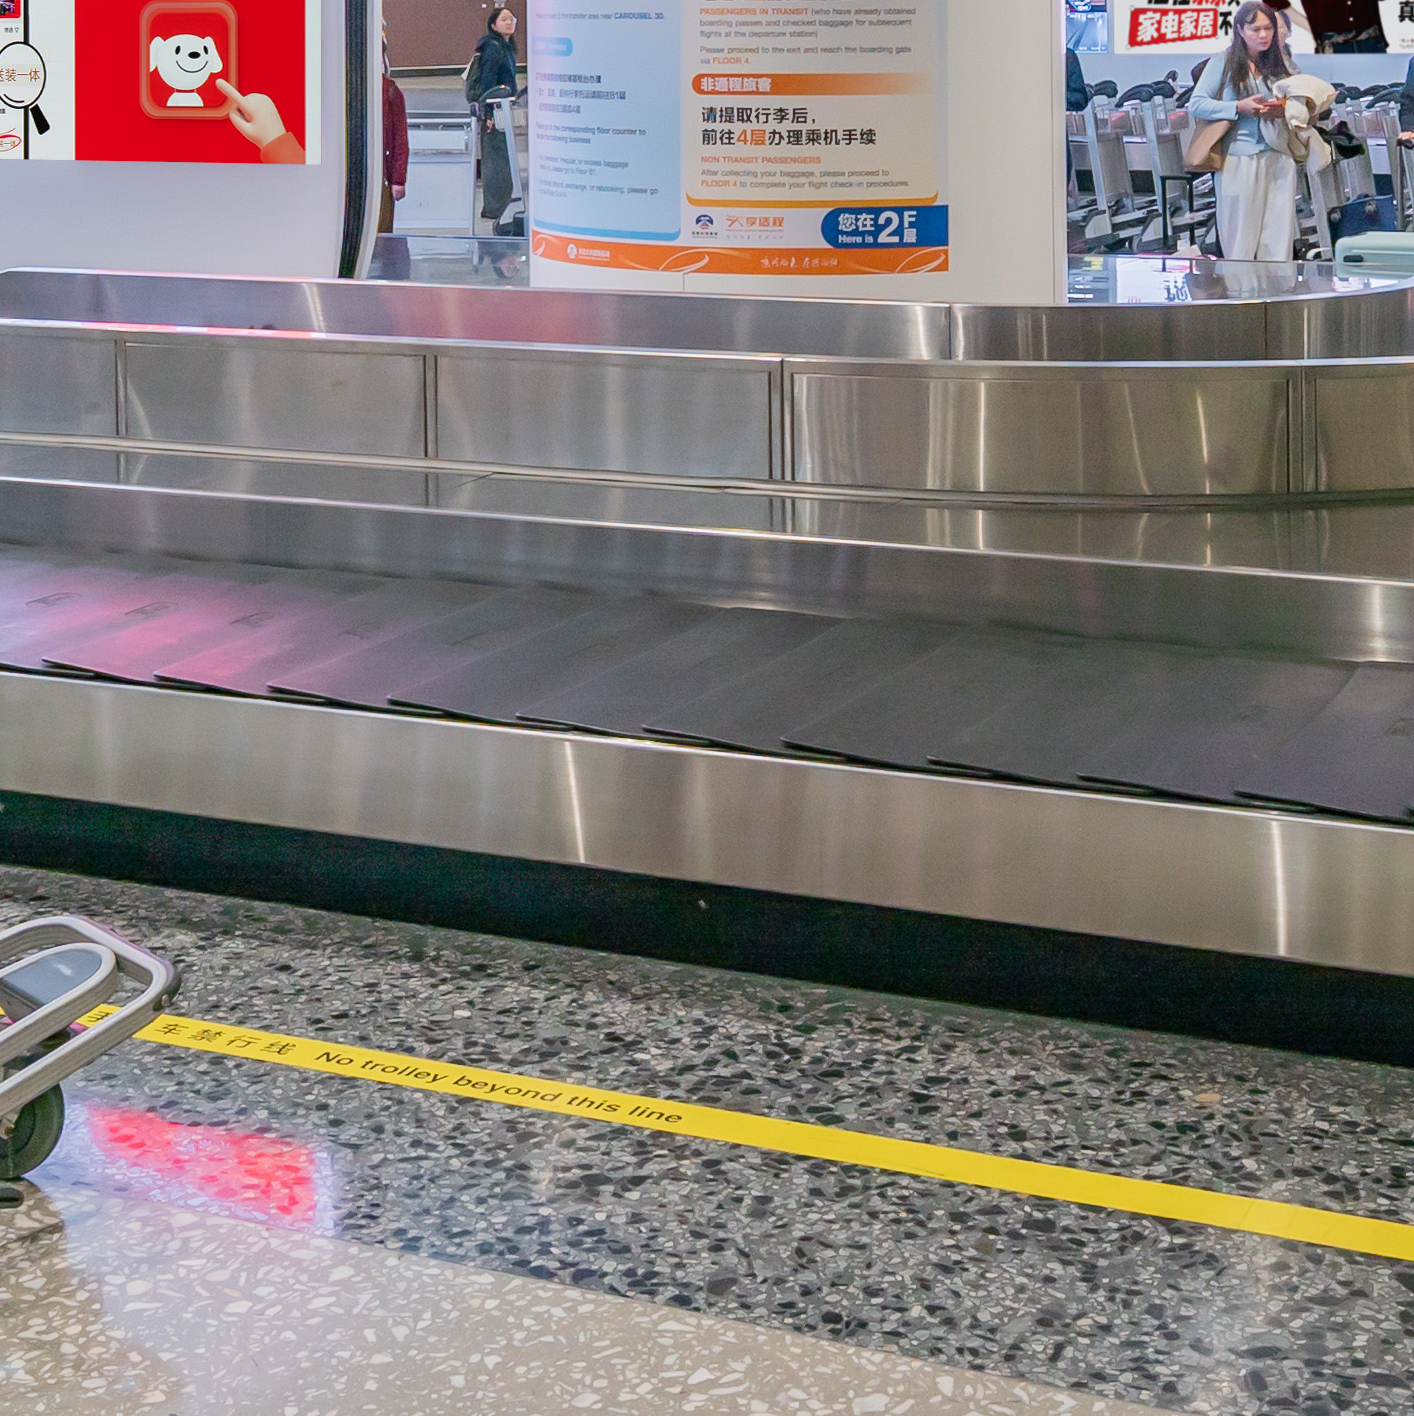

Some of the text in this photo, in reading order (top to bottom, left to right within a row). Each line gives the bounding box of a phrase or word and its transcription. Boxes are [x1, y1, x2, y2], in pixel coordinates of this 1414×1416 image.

[699, 7, 757, 16] PASSENGERS
[771, 7, 809, 16] TRANSIT
[700, 77, 772, 92] 非通程旅客
[701, 128, 876, 146] 前往4层办理乘机手续
[722, 156, 759, 164] TRANSIT
[761, 156, 822, 164] PASSENGERS
[701, 180, 730, 189] FLOOR
[838, 213, 875, 232] 您在
[877, 211, 900, 243] 2
[838, 234, 874, 244] Here is
[314, 1050, 685, 1124] No trolley beyond this line
